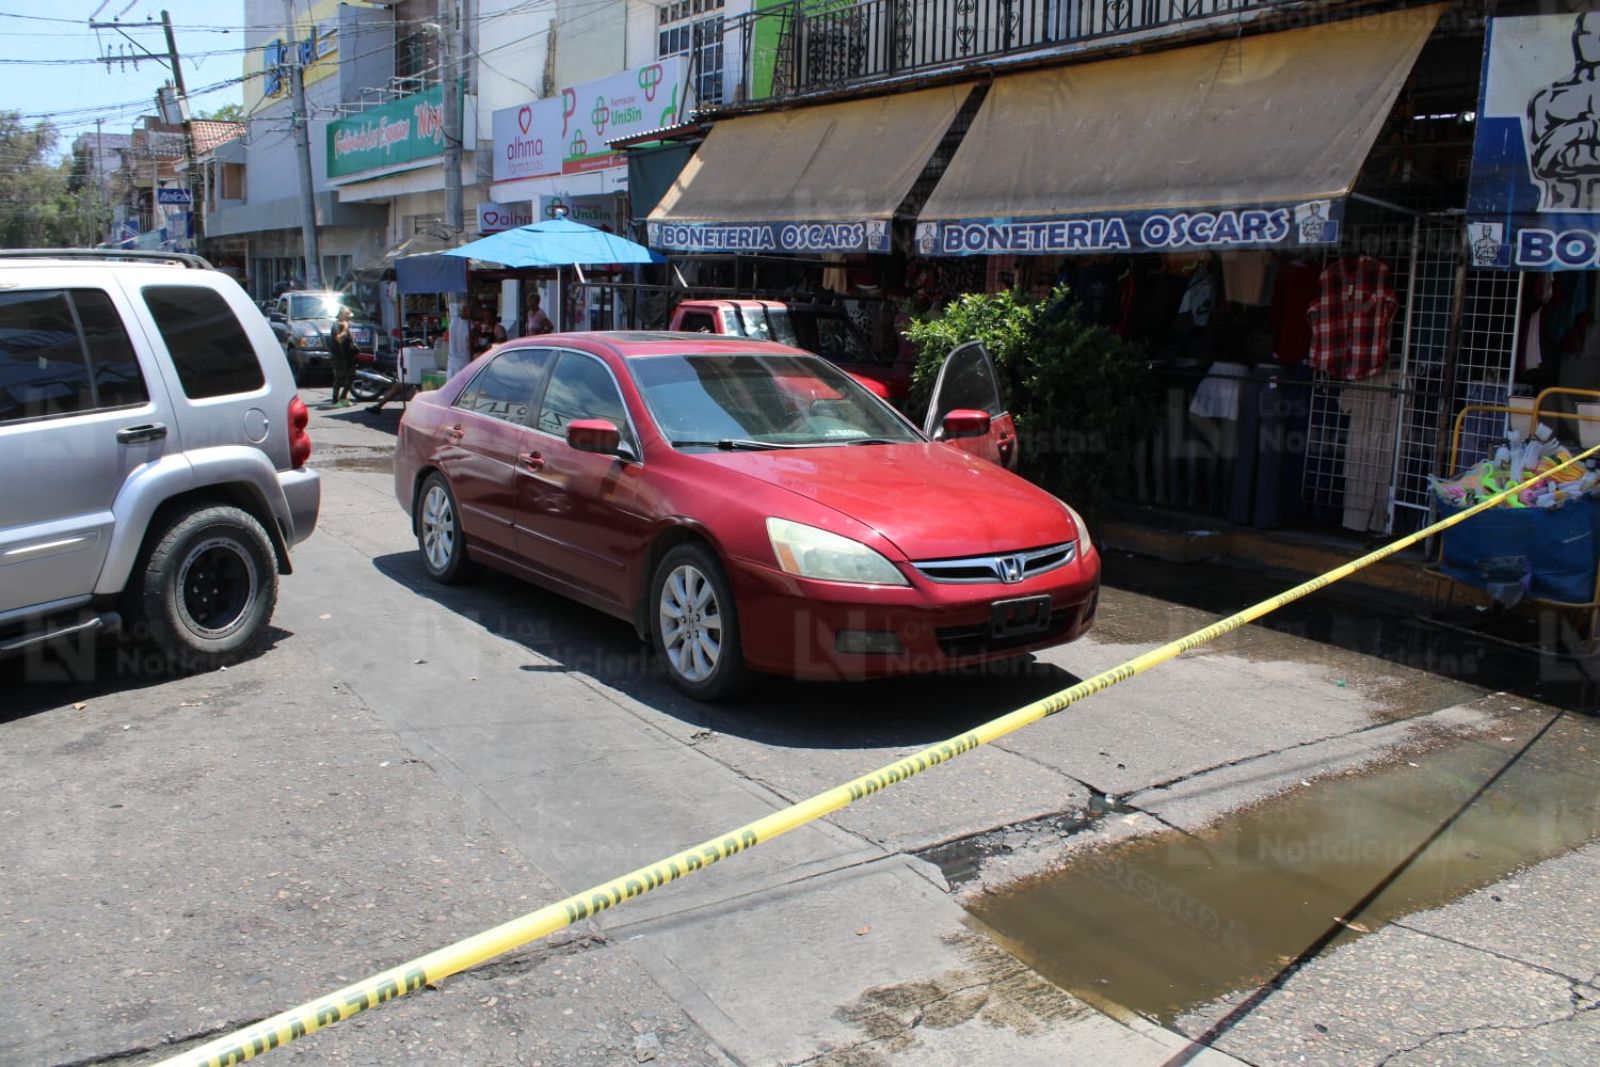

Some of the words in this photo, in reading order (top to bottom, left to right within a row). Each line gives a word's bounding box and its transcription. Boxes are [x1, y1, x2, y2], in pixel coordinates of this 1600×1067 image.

[611, 106, 642, 127] UniSin
[507, 135, 543, 161] alhma
[662, 225, 776, 250] BONETERIA
[780, 223, 865, 249] OSCARS
[943, 216, 1131, 252] BONETERIA
[1141, 209, 1291, 248] OSCARS
[1515, 228, 1600, 268] BO
